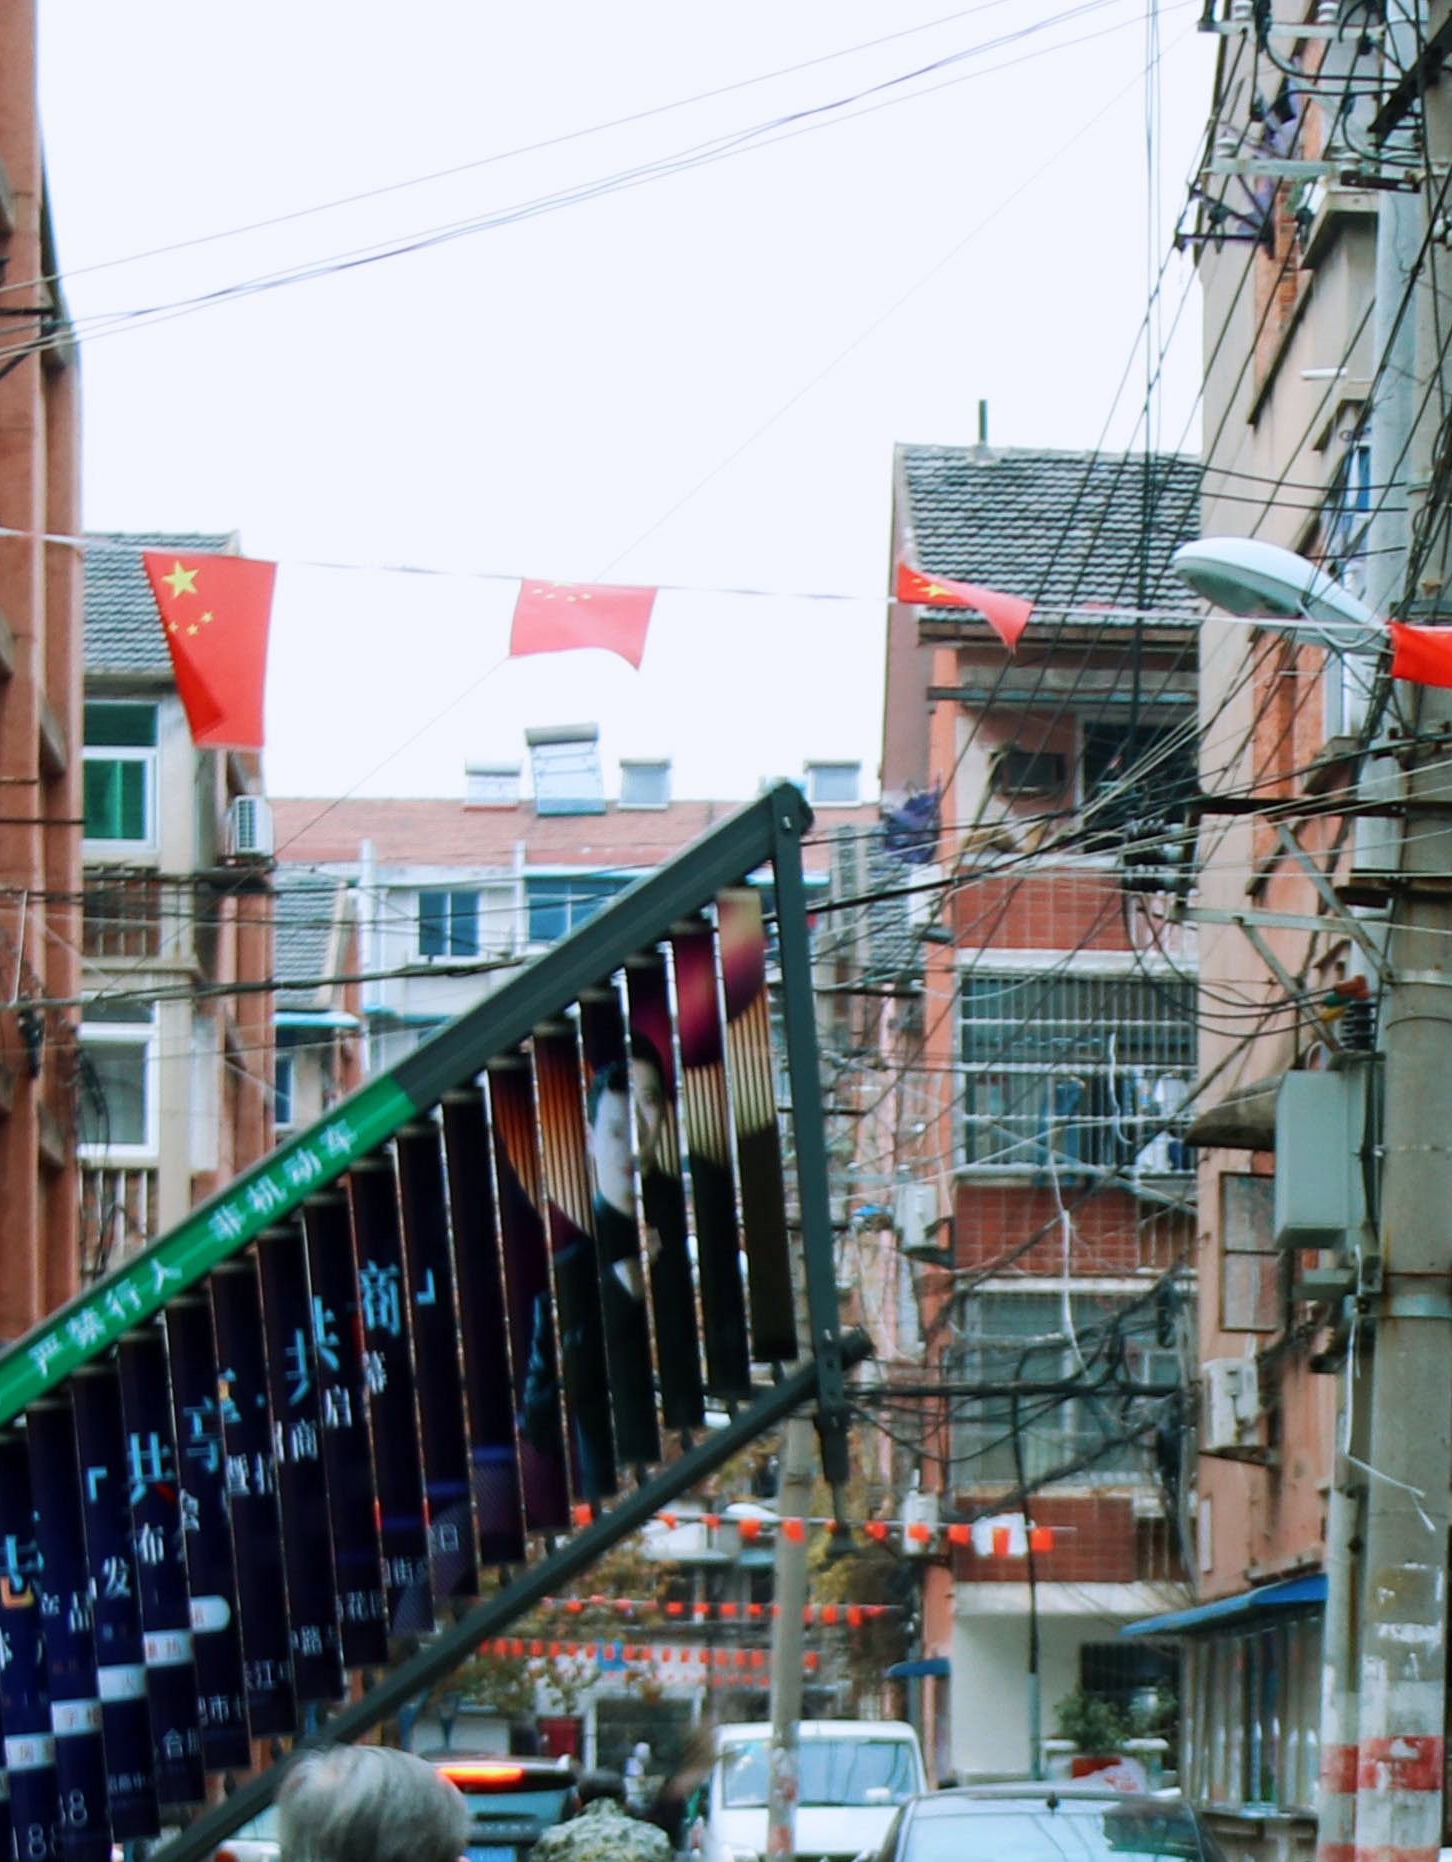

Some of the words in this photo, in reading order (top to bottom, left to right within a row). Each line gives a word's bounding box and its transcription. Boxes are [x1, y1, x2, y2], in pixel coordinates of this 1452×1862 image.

[28, 1257, 184, 1379] 严禁行人
[207, 1118, 359, 1242] 非机动车
